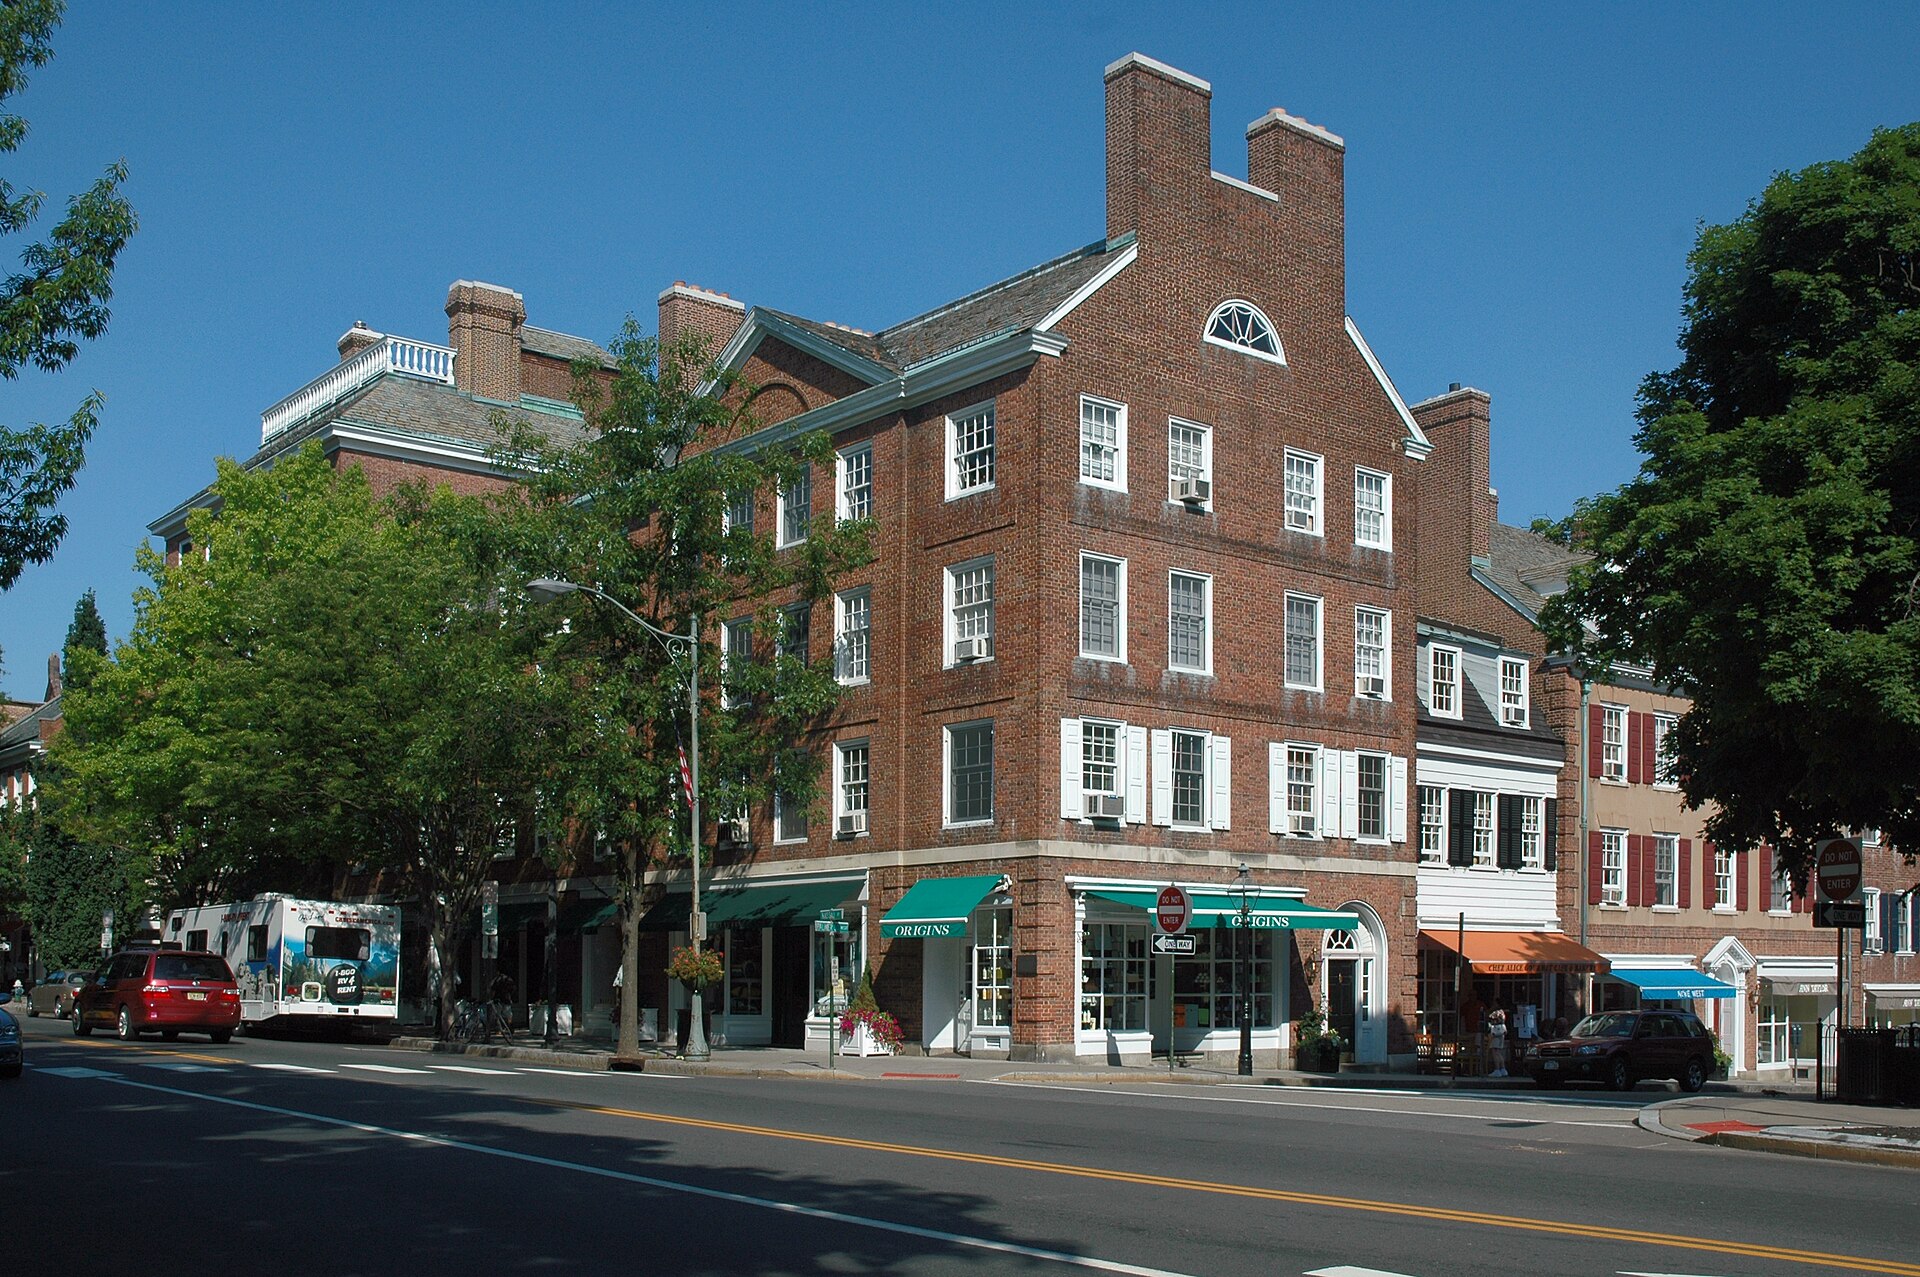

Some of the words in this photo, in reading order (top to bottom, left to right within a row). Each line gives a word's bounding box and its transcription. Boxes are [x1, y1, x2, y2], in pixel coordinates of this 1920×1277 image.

[1824, 853, 1835, 863] DO
[1839, 851, 1853, 862] NOT
[1827, 879, 1851, 889] ENTER
[1162, 896, 1169, 904] DO
[1171, 896, 1181, 904] NOT
[1833, 910, 1846, 920] ONE
[1163, 916, 1180, 924] ENTER
[894, 924, 950, 936] ORIGINS
[1164, 940, 1177, 949] ONE
[1178, 940, 1191, 949] WAY
[1488, 964, 1505, 972] CHEZ
[349, 976, 355, 985] 4
[337, 986, 356, 994] RENT
